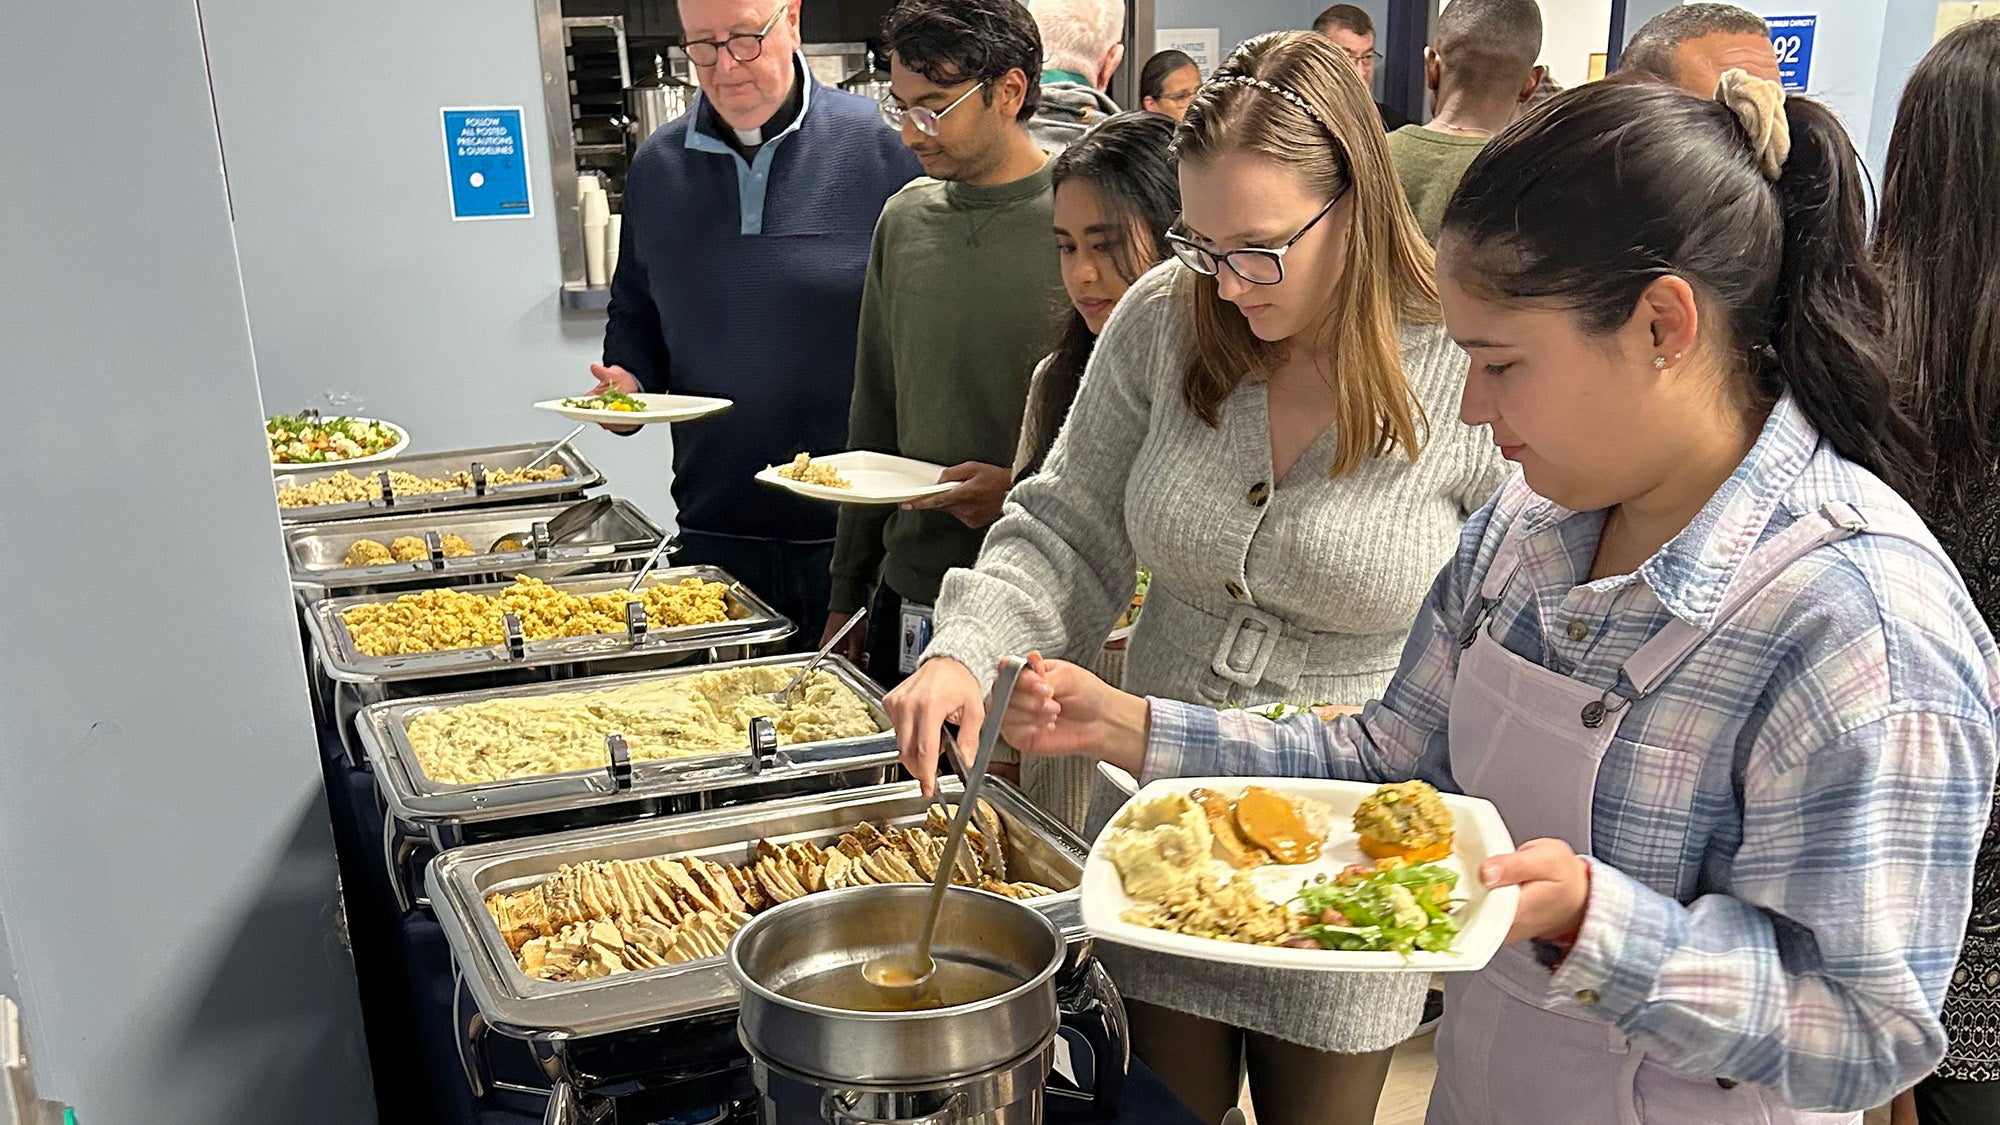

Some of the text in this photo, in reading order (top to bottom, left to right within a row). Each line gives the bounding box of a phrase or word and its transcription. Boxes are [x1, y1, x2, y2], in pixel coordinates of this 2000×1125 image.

[1790, 19, 1815, 27] CAPACITY
[1773, 36, 1801, 64] 92
[465, 117, 500, 127] FOLLOW
[461, 127, 507, 137] ALL POSTED
[456, 136, 513, 146] PRECAUTIONS
[458, 146, 514, 156] & GUIDELINES
